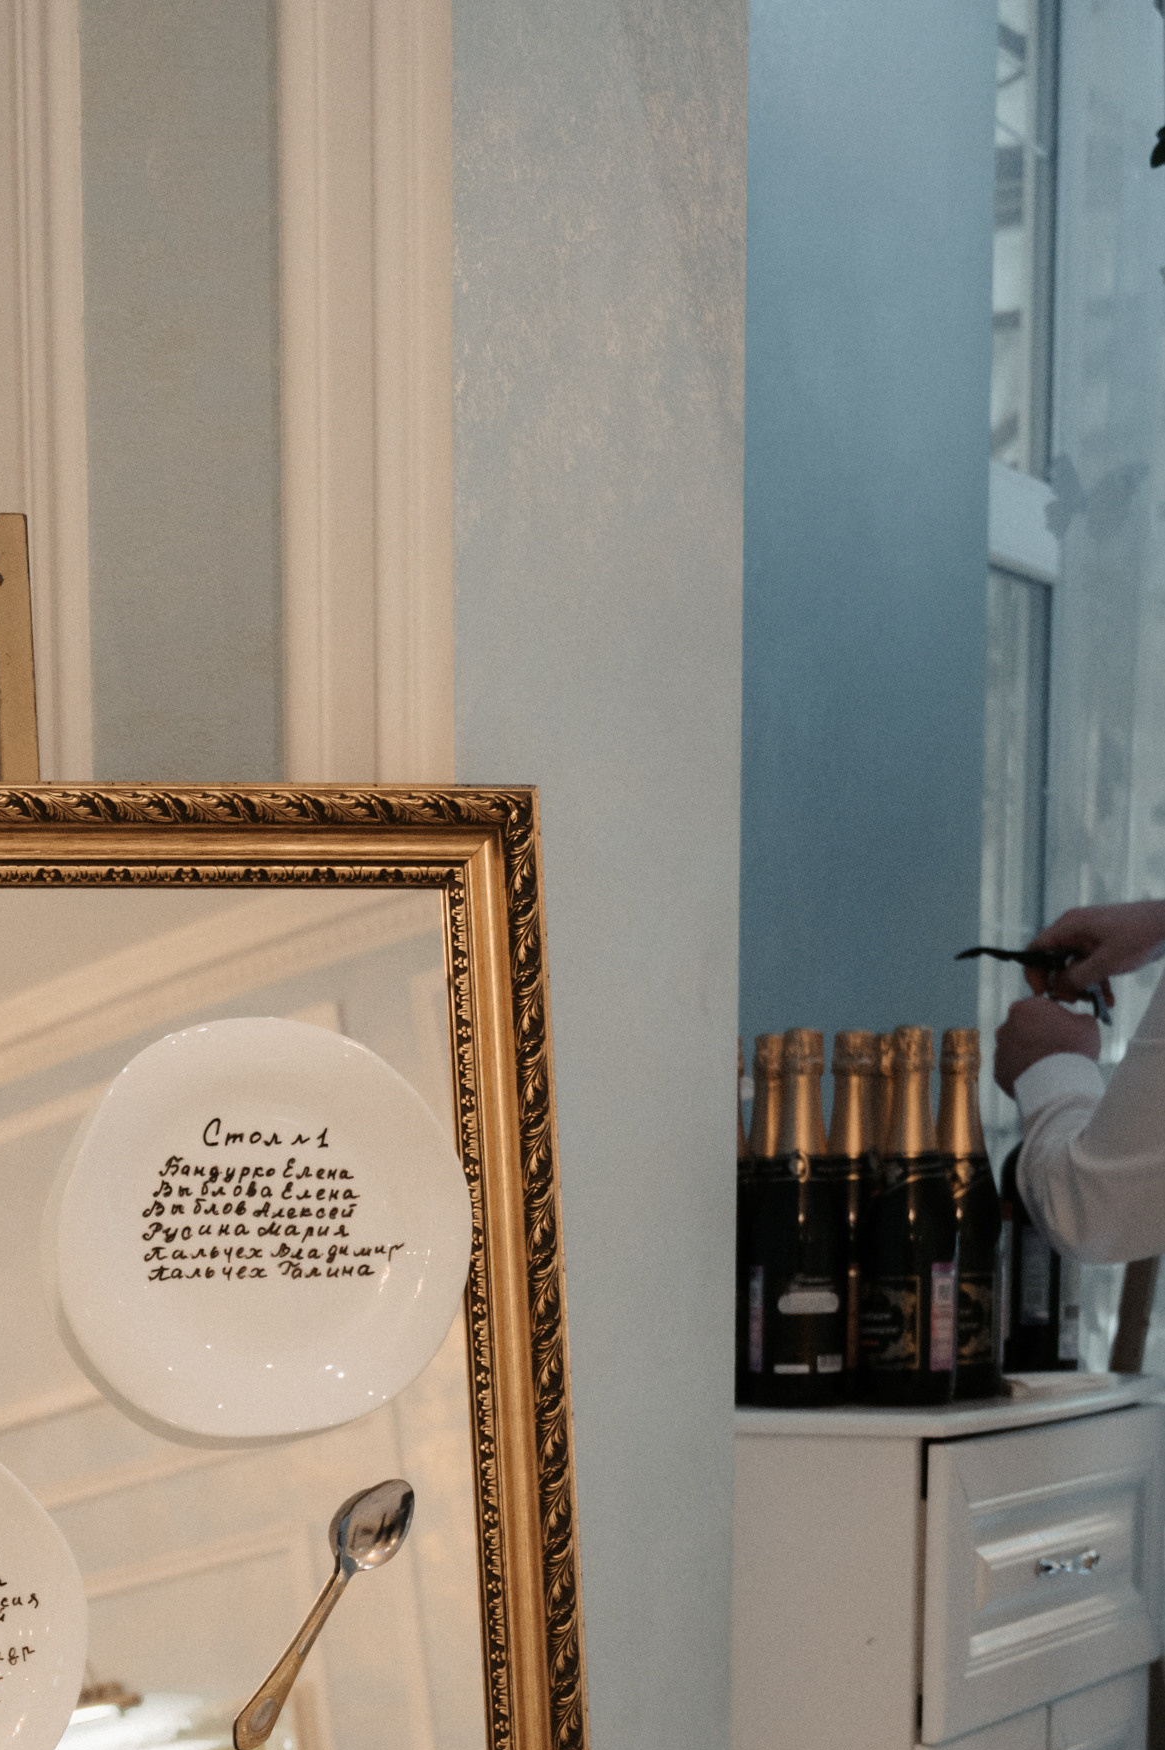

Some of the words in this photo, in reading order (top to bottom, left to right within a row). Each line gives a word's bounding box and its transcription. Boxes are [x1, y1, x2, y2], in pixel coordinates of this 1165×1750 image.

[203, 1118, 282, 1147] Стол
[317, 1128, 329, 1148] 1
[159, 1155, 275, 1182] Бандурко
[283, 1157, 354, 1179] Елена
[281, 1182, 360, 1200] Елена
[253, 1202, 357, 1220] Алексей
[142, 1222, 250, 1243] Русина
[257, 1222, 349, 1243] Мария
[144, 1246, 263, 1266] Пальчех
[270, 1243, 405, 1262] Владимир
[148, 1266, 267, 1281] Пальчех
[277, 1261, 375, 1280] Галина
